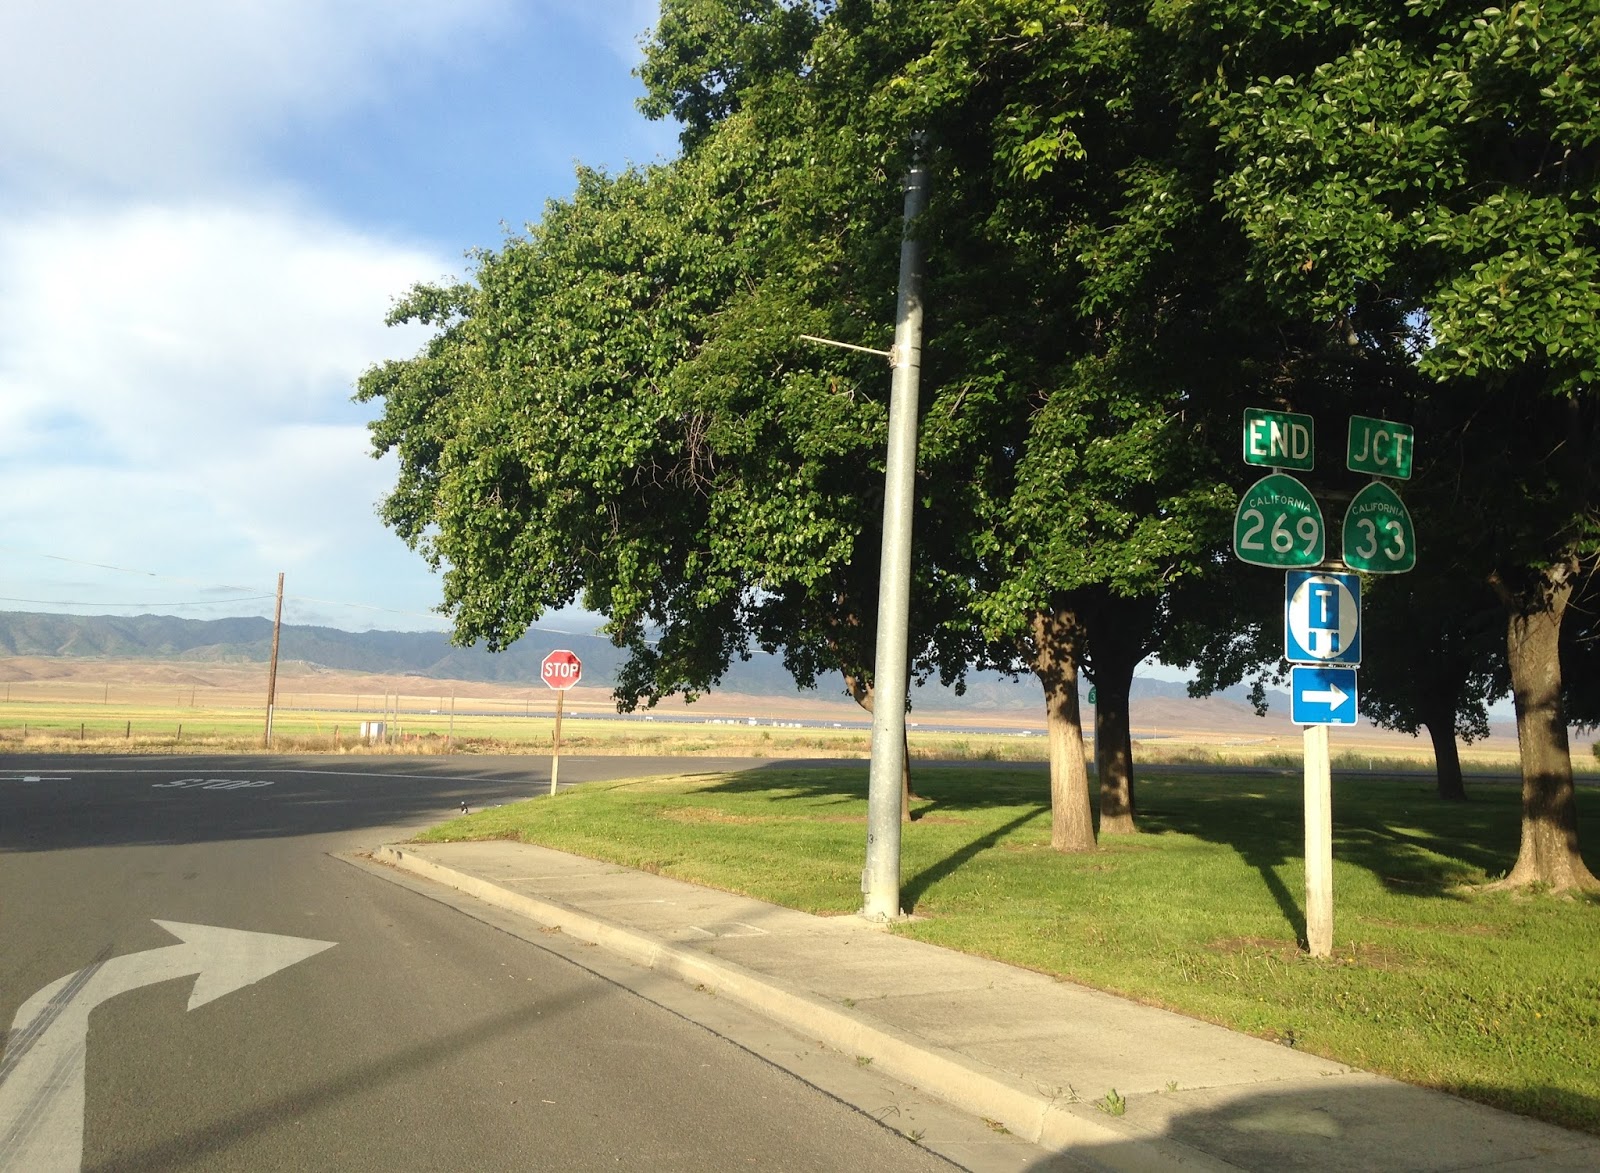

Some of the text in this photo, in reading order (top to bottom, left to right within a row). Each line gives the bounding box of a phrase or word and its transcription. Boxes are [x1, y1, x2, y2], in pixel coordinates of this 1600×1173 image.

[1250, 419, 1309, 460] END
[1353, 427, 1408, 468] JCT
[1249, 495, 1311, 513] CALIFORNIA
[1351, 502, 1404, 519] CALIFORNIA
[1240, 509, 1319, 557] 269
[1355, 518, 1406, 561] 33
[544, 662, 579, 678] STOP
[151, 778, 275, 790] STOP
